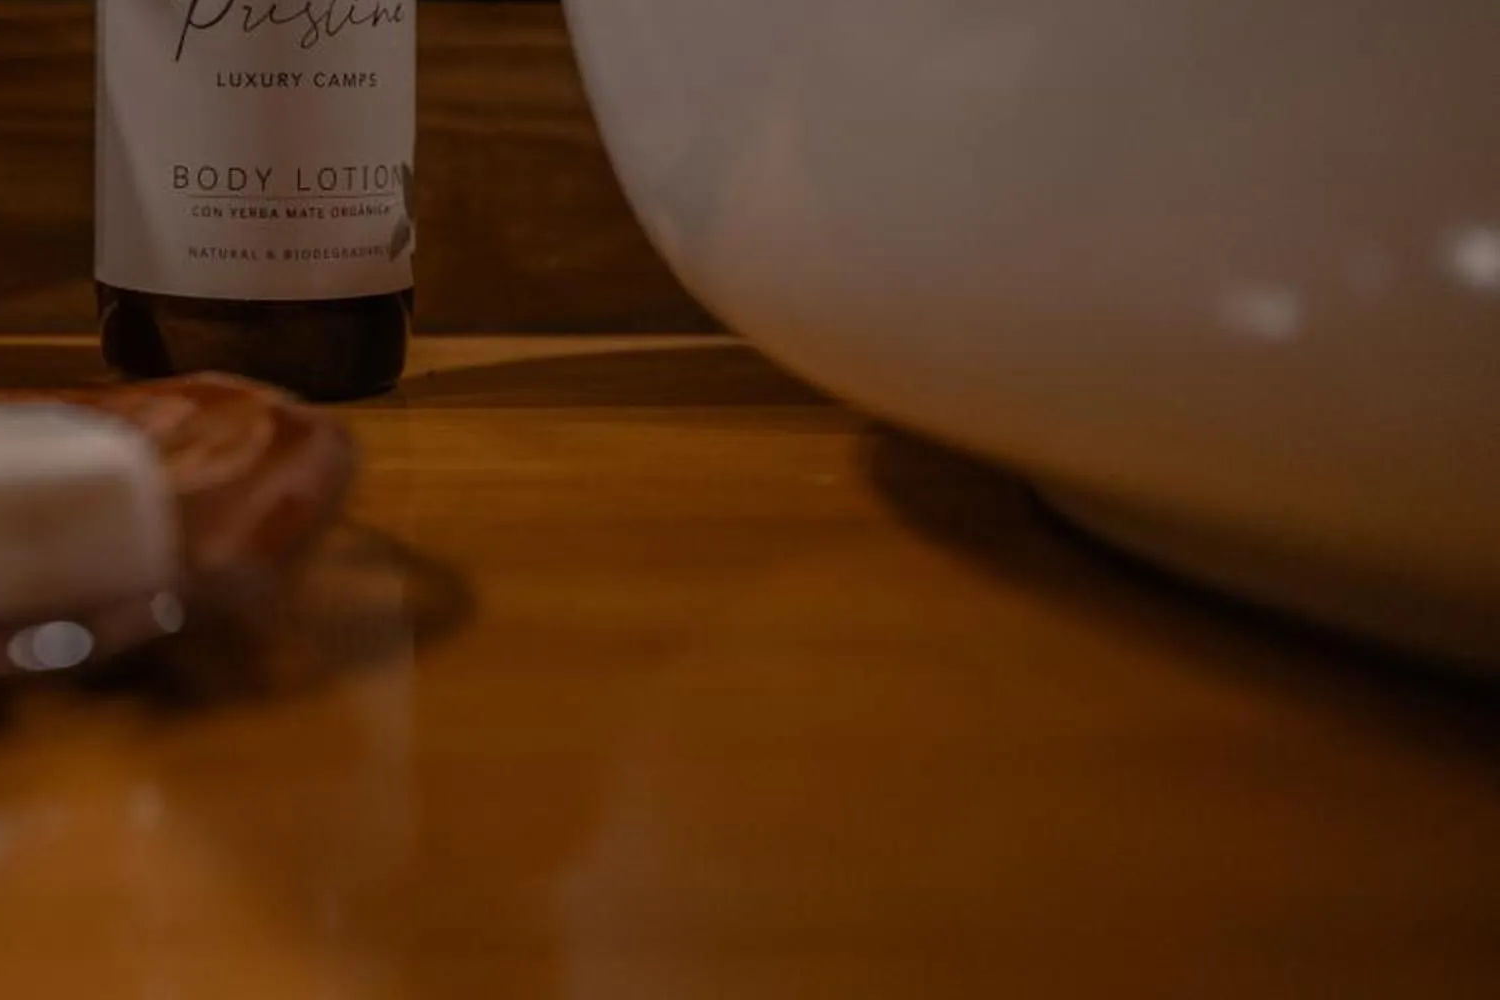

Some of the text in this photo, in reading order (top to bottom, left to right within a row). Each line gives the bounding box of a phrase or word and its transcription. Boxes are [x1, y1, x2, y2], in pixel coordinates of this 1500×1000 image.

[216, 71, 379, 88] LUXURY CAMPS
[172, 163, 402, 192] BODY LOTION
[191, 204, 223, 218] CON
[229, 205, 279, 219] YERBA
[285, 205, 325, 219] MATE
[188, 245, 258, 261] NATURAL
[265, 248, 277, 261] &
